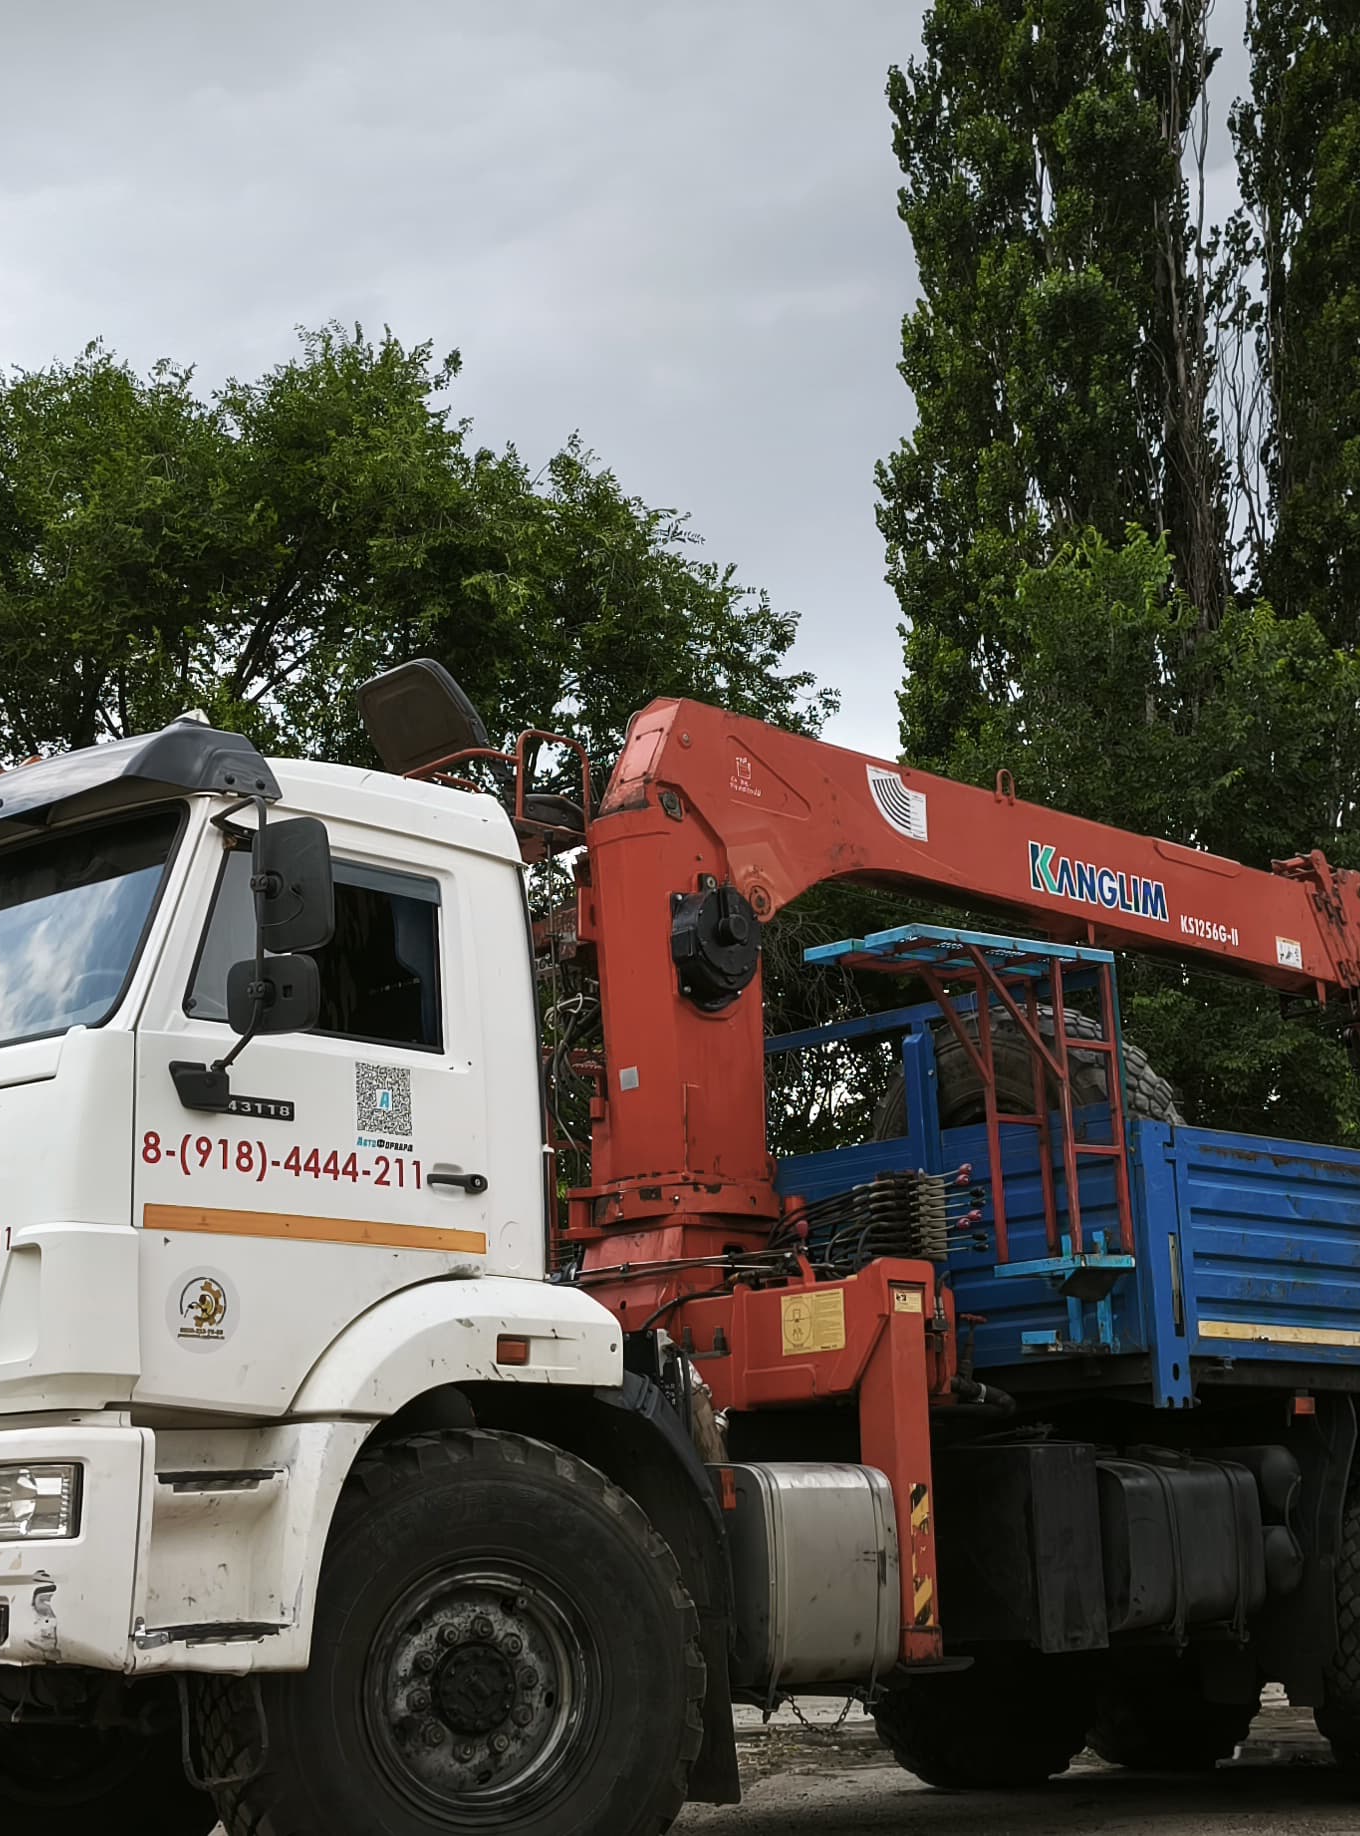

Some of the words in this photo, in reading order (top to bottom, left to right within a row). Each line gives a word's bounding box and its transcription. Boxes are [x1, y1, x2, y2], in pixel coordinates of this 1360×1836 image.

[1028, 840, 1169, 922] KANGLIM
[1180, 914, 1239, 947] KS1256G-II
[228, 1100, 290, 1117] 43118
[141, 1130, 423, 1190] 8-(918)-4444-211
